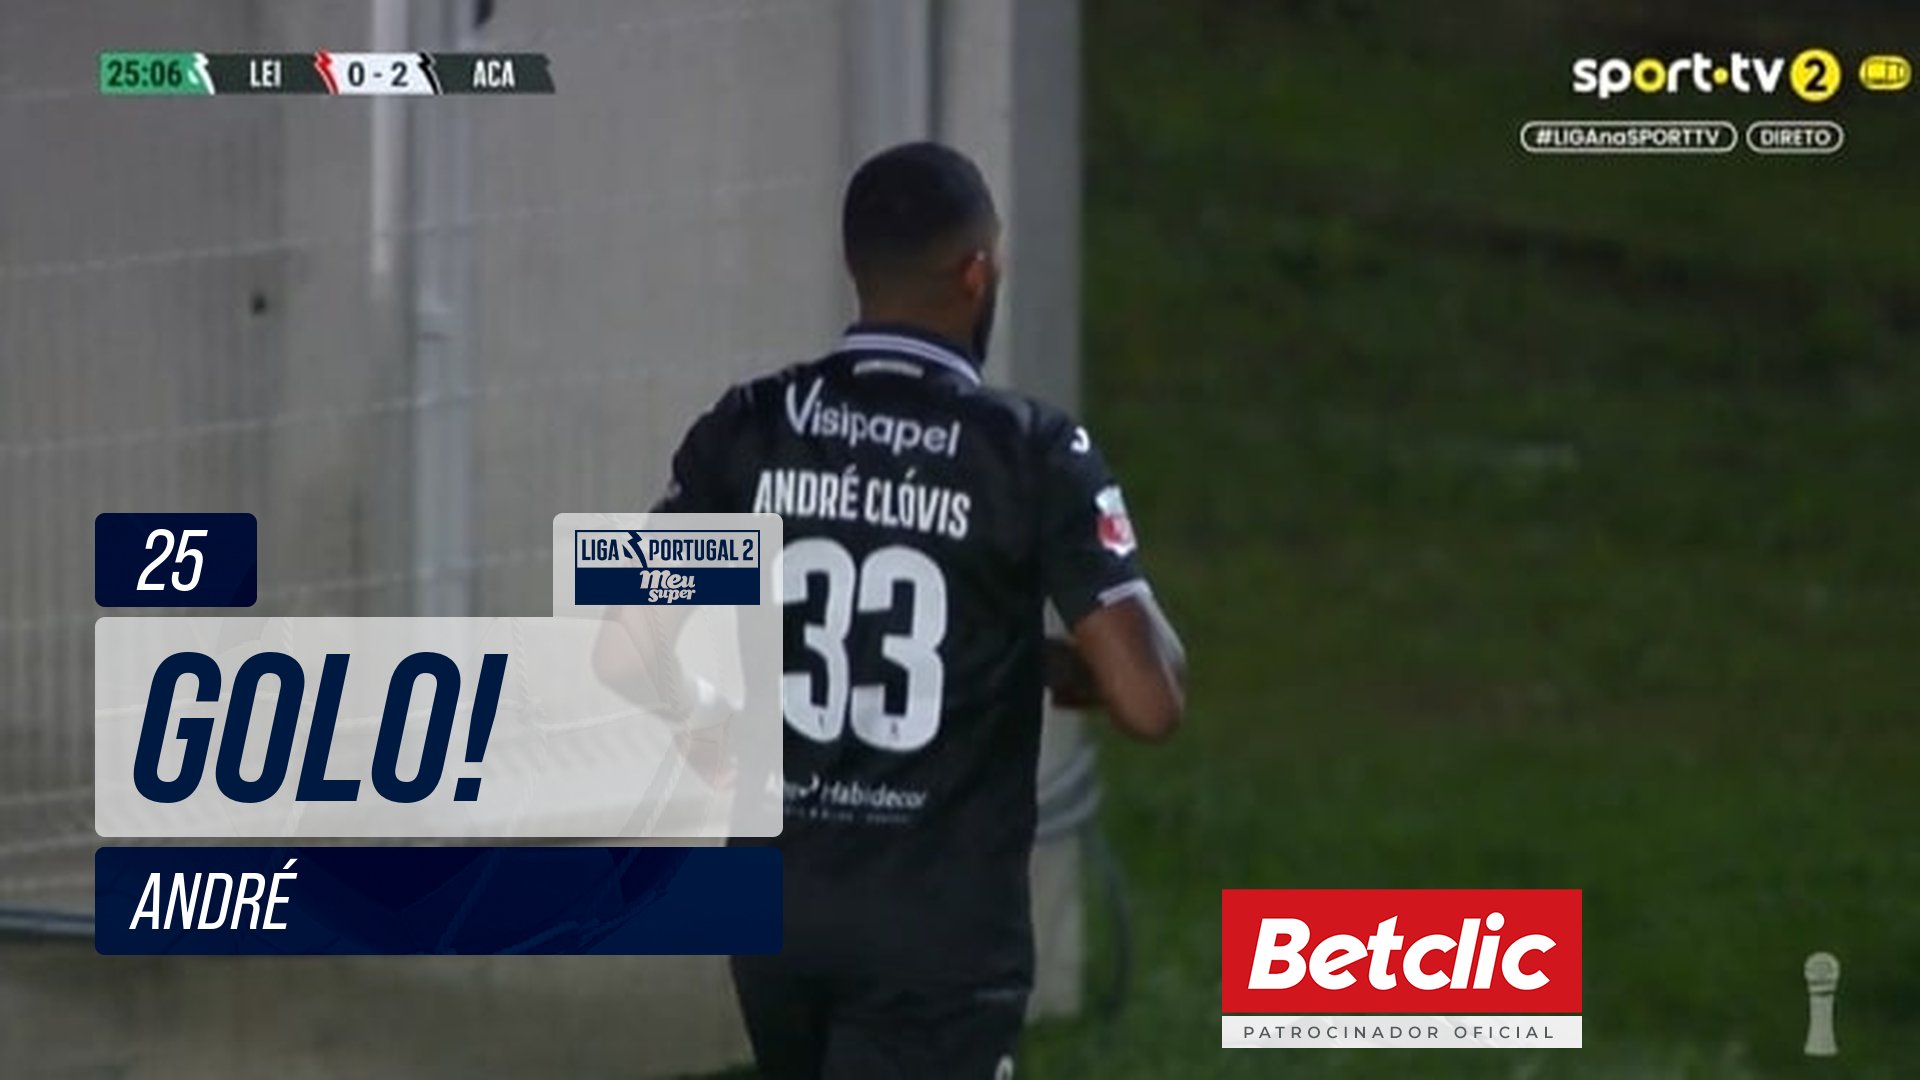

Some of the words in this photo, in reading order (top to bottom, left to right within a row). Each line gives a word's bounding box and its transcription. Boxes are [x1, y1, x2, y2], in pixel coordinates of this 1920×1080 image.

[785, 377, 961, 457] Visipapel
[754, 465, 861, 517] ANDRÉ
[864, 468, 972, 539] CLÓVIS
[772, 537, 948, 752] 33
